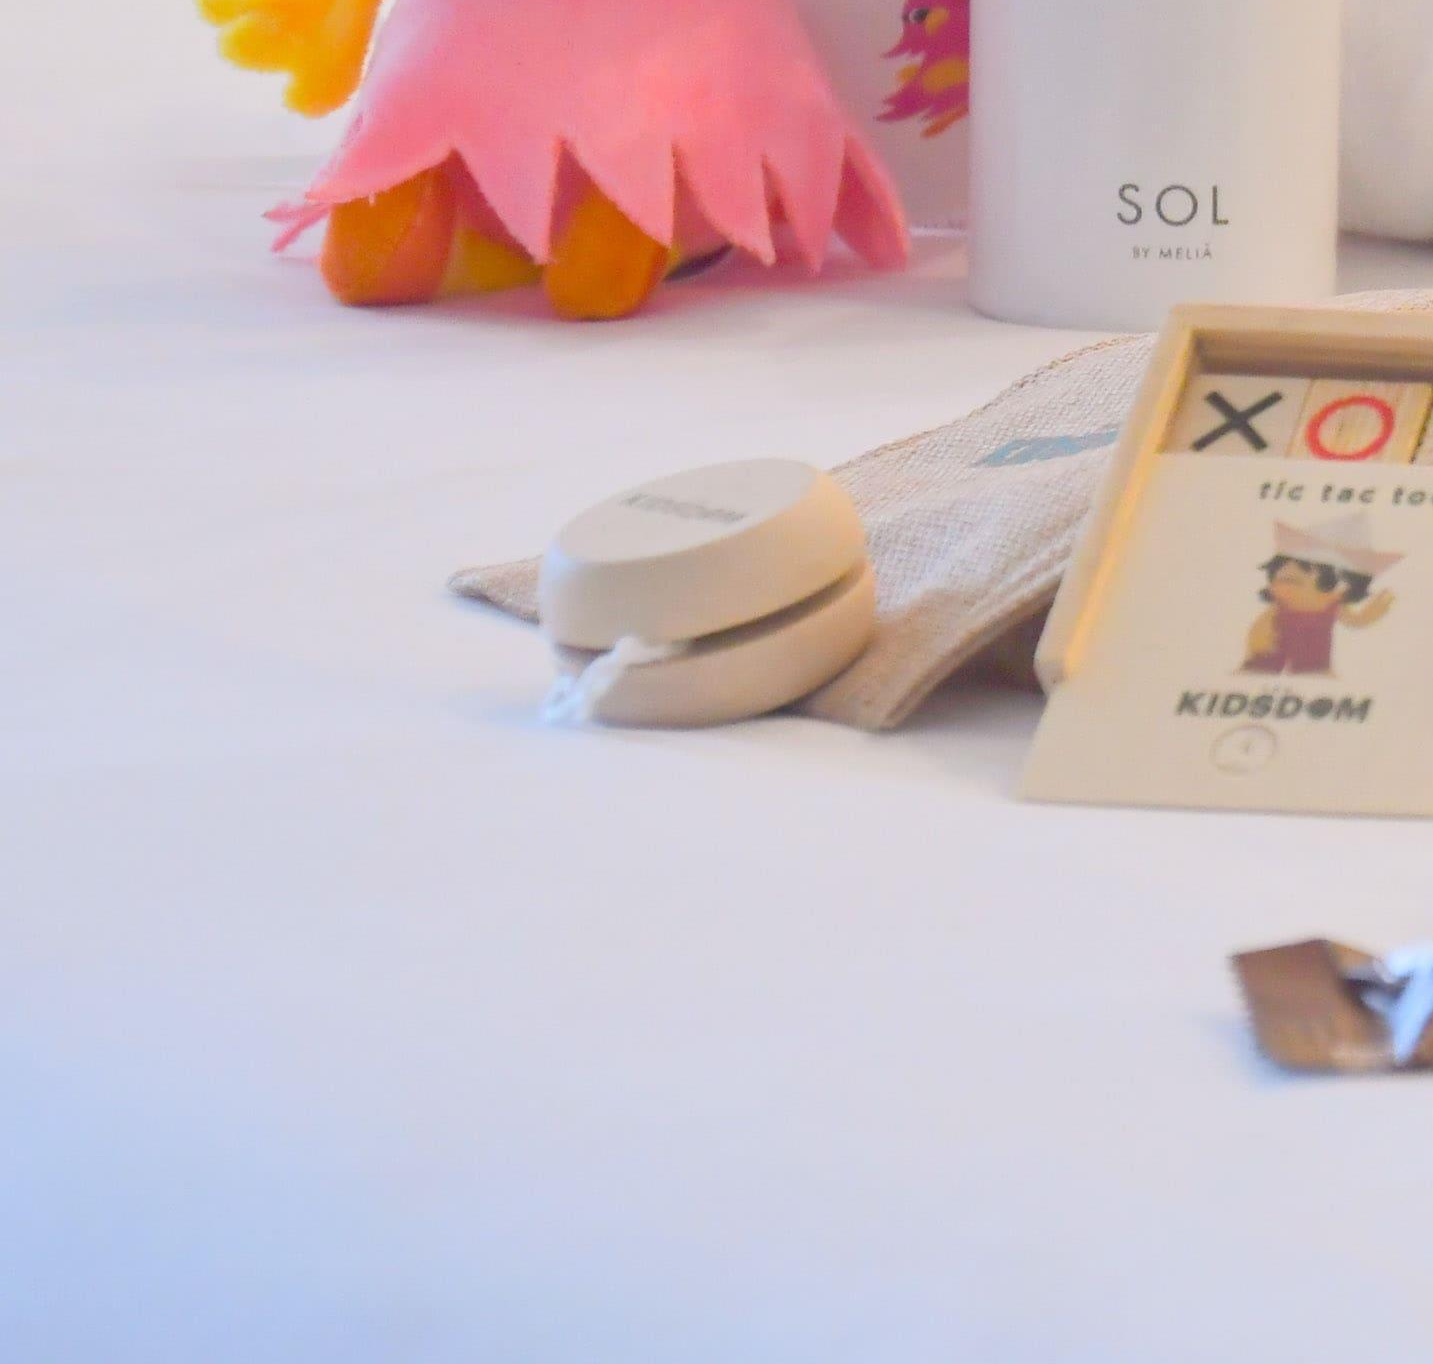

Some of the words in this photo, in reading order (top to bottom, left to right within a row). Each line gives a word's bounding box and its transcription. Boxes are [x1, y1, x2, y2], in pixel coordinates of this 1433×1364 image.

[1117, 183, 1229, 226] SOL
[1132, 246, 1150, 259] BY
[1190, 390, 1284, 454] X
[1304, 394, 1396, 462] O
[1259, 479, 1304, 501] tic
[1321, 483, 1375, 504] tac
[1176, 691, 1372, 723] KIDSDOM
